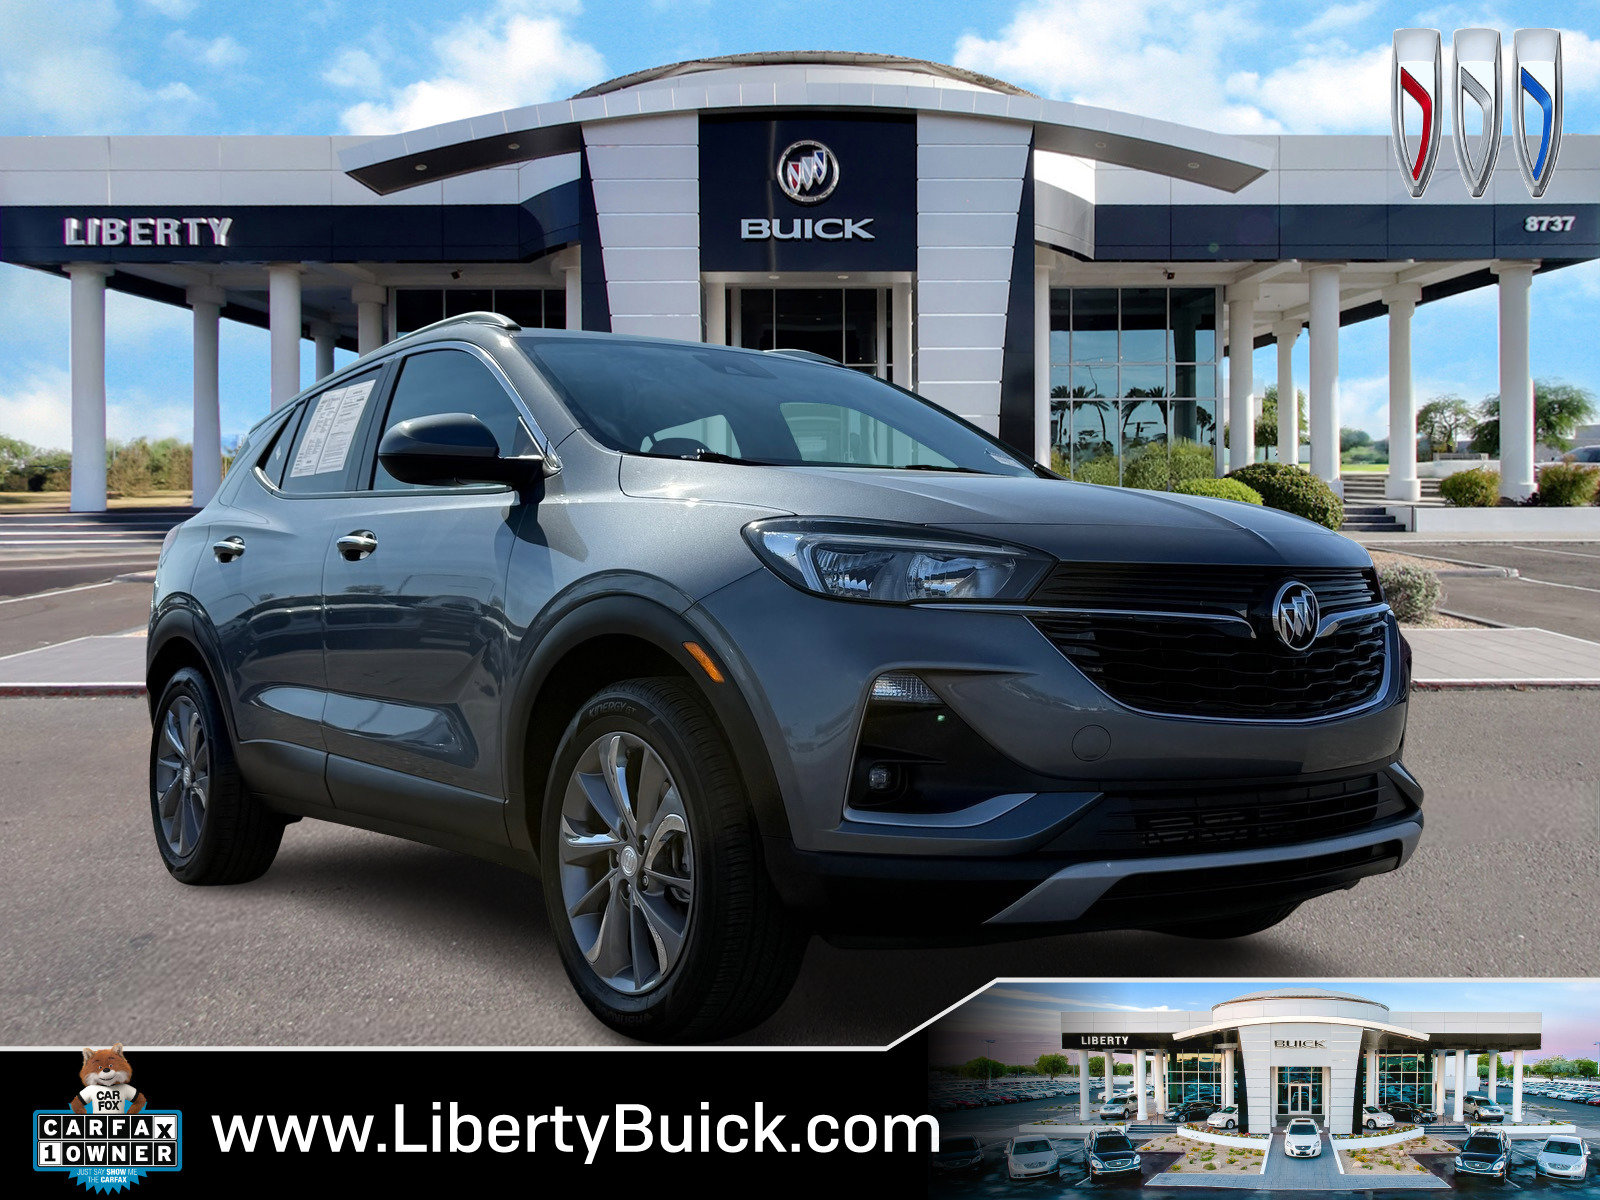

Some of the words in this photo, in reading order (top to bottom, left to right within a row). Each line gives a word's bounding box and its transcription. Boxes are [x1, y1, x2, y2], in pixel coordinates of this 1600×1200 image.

[64, 217, 233, 246] LIBERTY
[740, 218, 876, 239] BUICK
[1524, 215, 1576, 232] 8737
